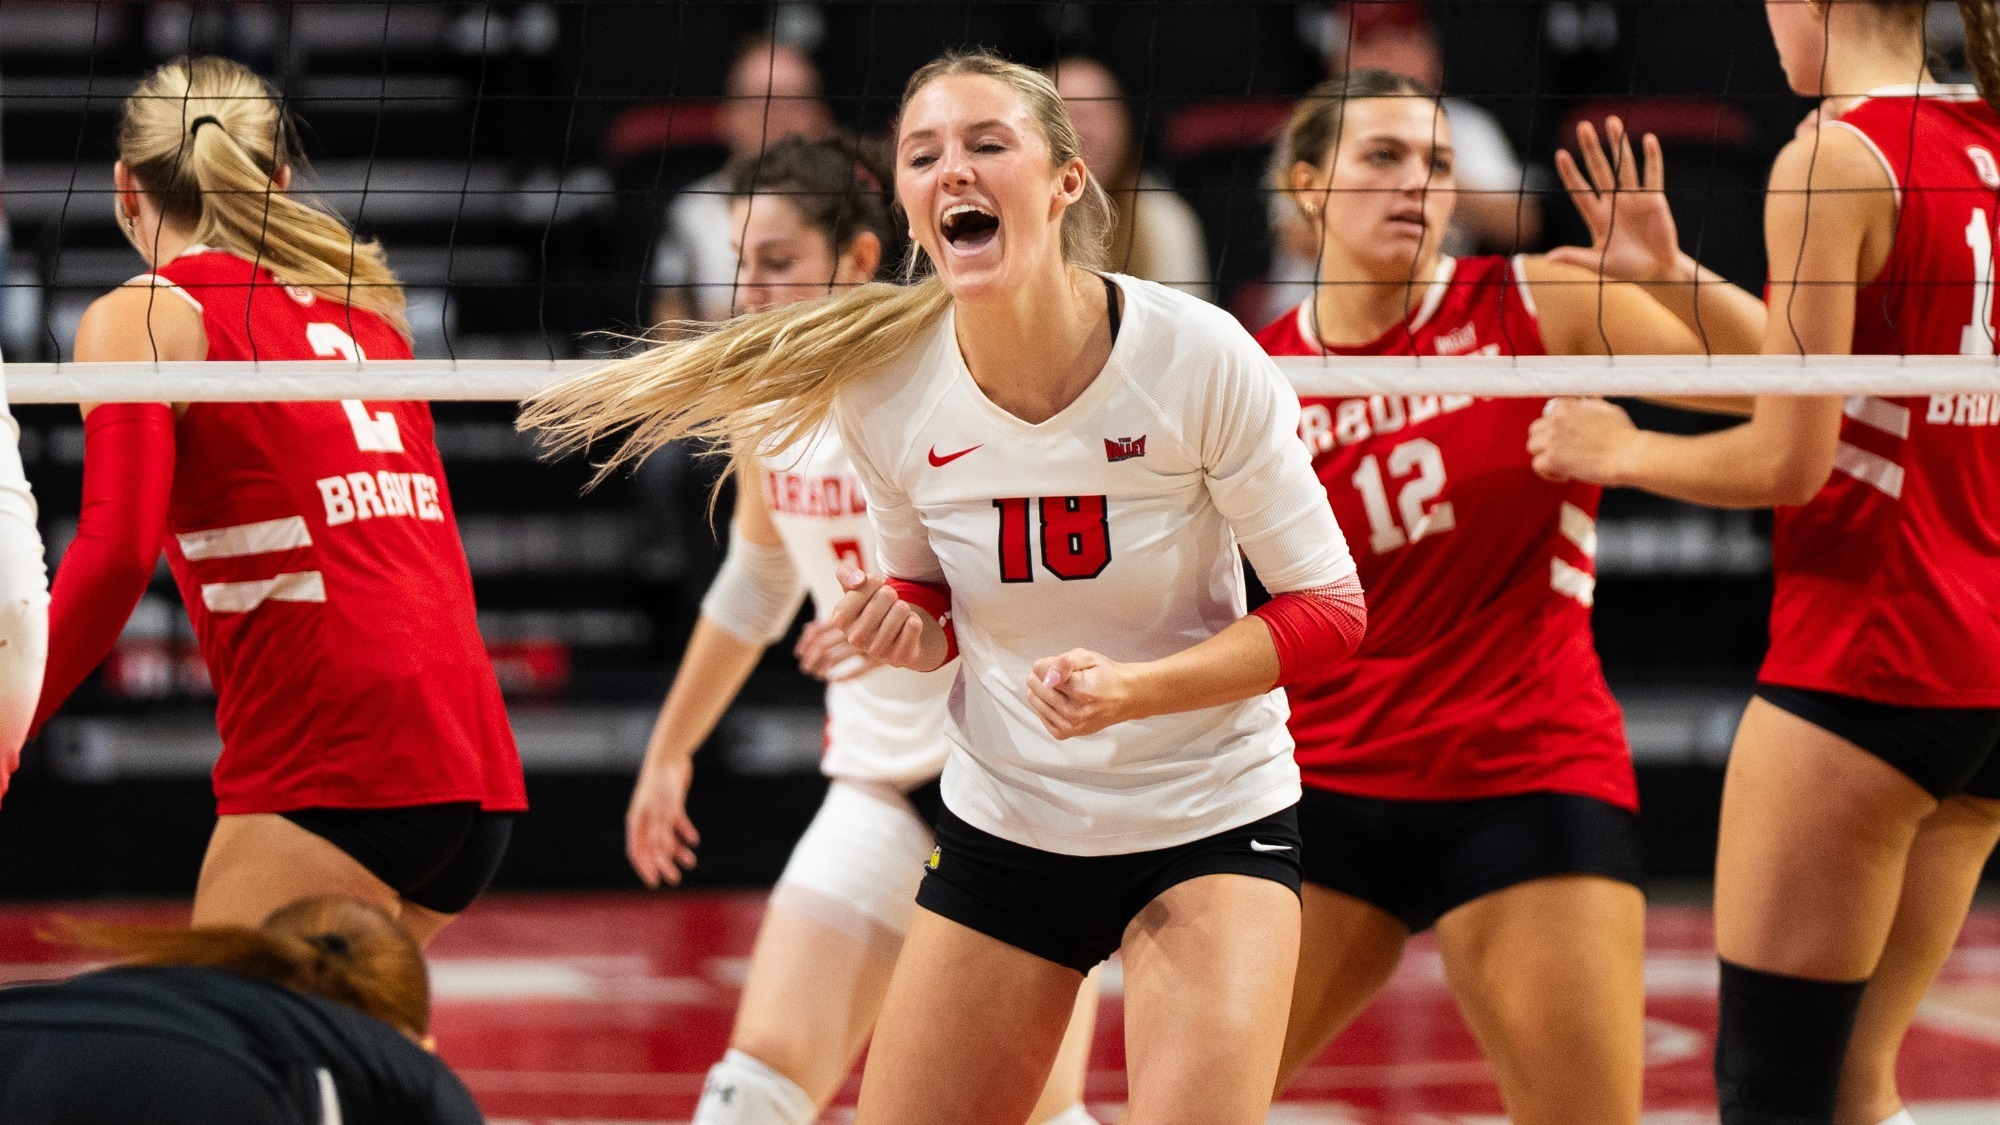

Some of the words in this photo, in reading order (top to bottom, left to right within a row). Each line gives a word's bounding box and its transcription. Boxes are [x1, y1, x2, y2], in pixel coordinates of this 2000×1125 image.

[1959, 206, 2000, 355] 1
[306, 322, 404, 452] 2
[1104, 435, 1146, 459] VALLEY
[1352, 437, 1456, 555] 12
[992, 495, 1112, 583] 18
